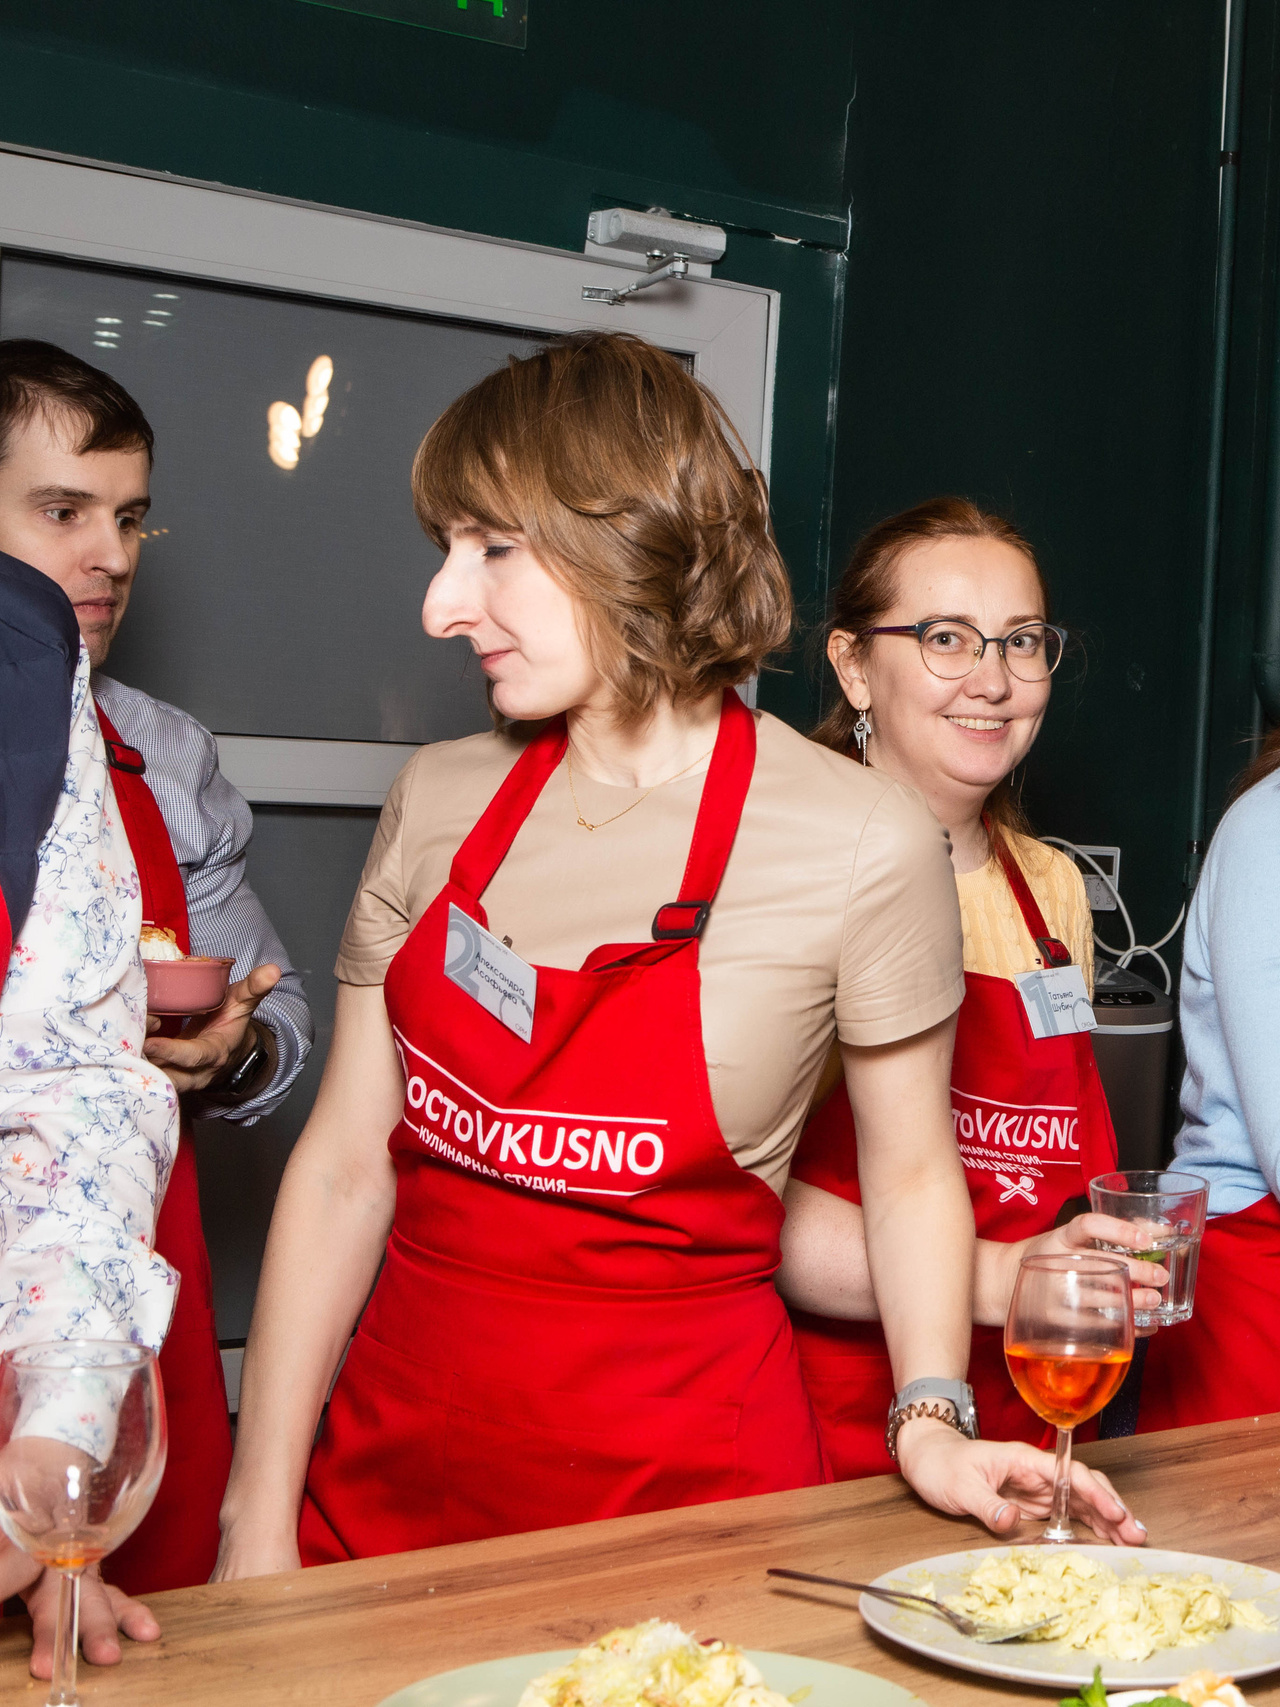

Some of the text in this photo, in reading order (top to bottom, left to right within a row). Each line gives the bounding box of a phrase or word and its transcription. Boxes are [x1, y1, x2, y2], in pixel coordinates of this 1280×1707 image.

[474, 964, 518, 1005] Асафьева
[475, 951, 525, 997] Александра
[1048, 991, 1074, 1001] Татьяна
[418, 1124, 567, 1194] КУЛИНАРНАЯ СТУДИЯ
[960, 1156, 1045, 1178] MAUNFELD
[1002, 1151, 1042, 1166] СТУДИЯ
